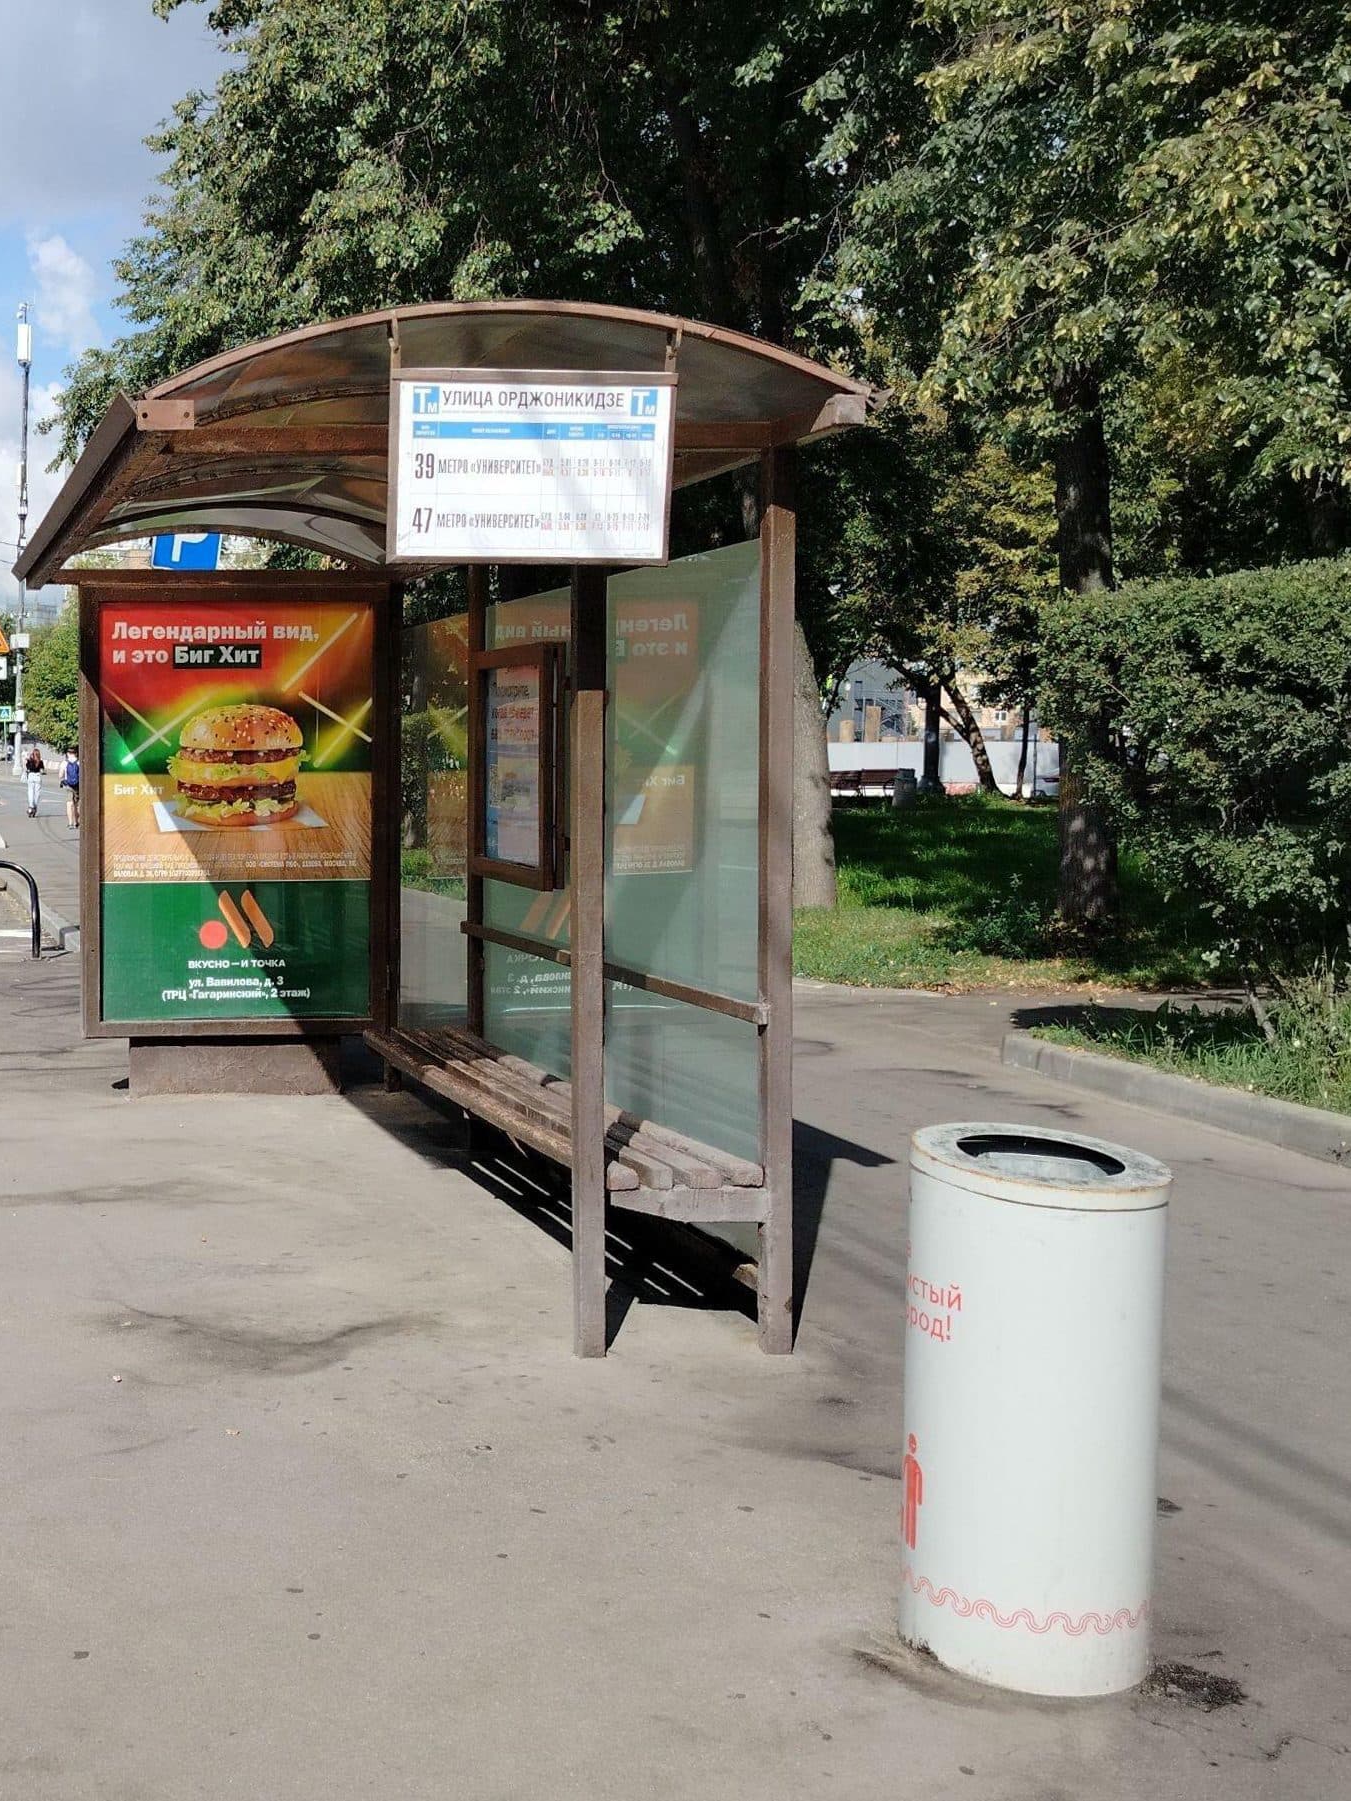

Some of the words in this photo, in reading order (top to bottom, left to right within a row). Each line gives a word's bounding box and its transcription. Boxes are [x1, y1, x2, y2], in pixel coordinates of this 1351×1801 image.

[442, 390, 493, 408] УЛИЦА
[498, 391, 625, 410] ОРДЖОНИКИДЗЕ
[415, 453, 435, 479] 39
[437, 458, 469, 474] МЕТРО
[470, 458, 542, 475] «УНИВЕРСИТЕТ»
[412, 507, 433, 533] 47
[436, 513, 467, 529] МЕТРО
[469, 513, 540, 529] «УНИВЕРСИТЕТ»
[112, 621, 267, 643] Легендарный
[273, 625, 319, 643] вид,
[112, 650, 126, 664] и
[131, 650, 169, 664] это
[174, 645, 214, 664] Биг
[219, 645, 260, 664] Хит
[113, 784, 137, 795] Биг
[140, 784, 164, 795] Хит
[188, 960, 230, 969] ВКУСНО
[241, 960, 249, 968] И
[250, 959, 286, 968] ТОЧКА
[189, 978, 204, 989] ул.
[206, 977, 263, 988] Вавилова,
[264, 978, 274, 988] д.
[276, 976, 284, 985] 3
[162, 990, 187, 1001] (ТРЦ
[270, 988, 278, 998] 2
[279, 987, 311, 999] этаж)
[906, 1273, 962, 1312] истый
[906, 1303, 952, 1343] род!
